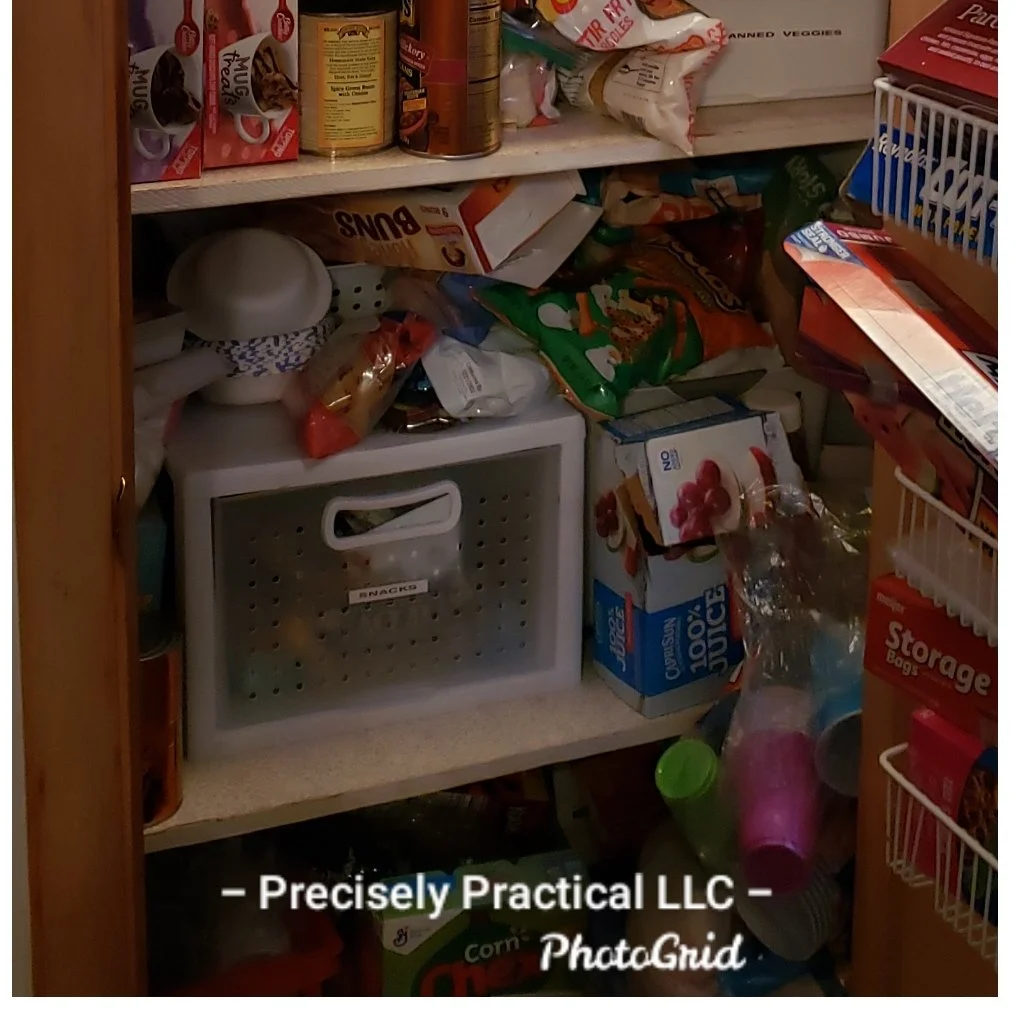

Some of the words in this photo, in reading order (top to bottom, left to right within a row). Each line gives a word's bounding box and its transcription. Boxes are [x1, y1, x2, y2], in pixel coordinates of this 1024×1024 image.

[728, 30, 775, 40] ANNED
[783, 28, 843, 39] VEGGIES
[335, 205, 423, 243] BUNS
[358, 583, 418, 600] SNACKS
[688, 603, 708, 674] 100%
[707, 584, 729, 674] JUICE
[884, 620, 993, 697] Storage
[886, 648, 921, 677] Bags
